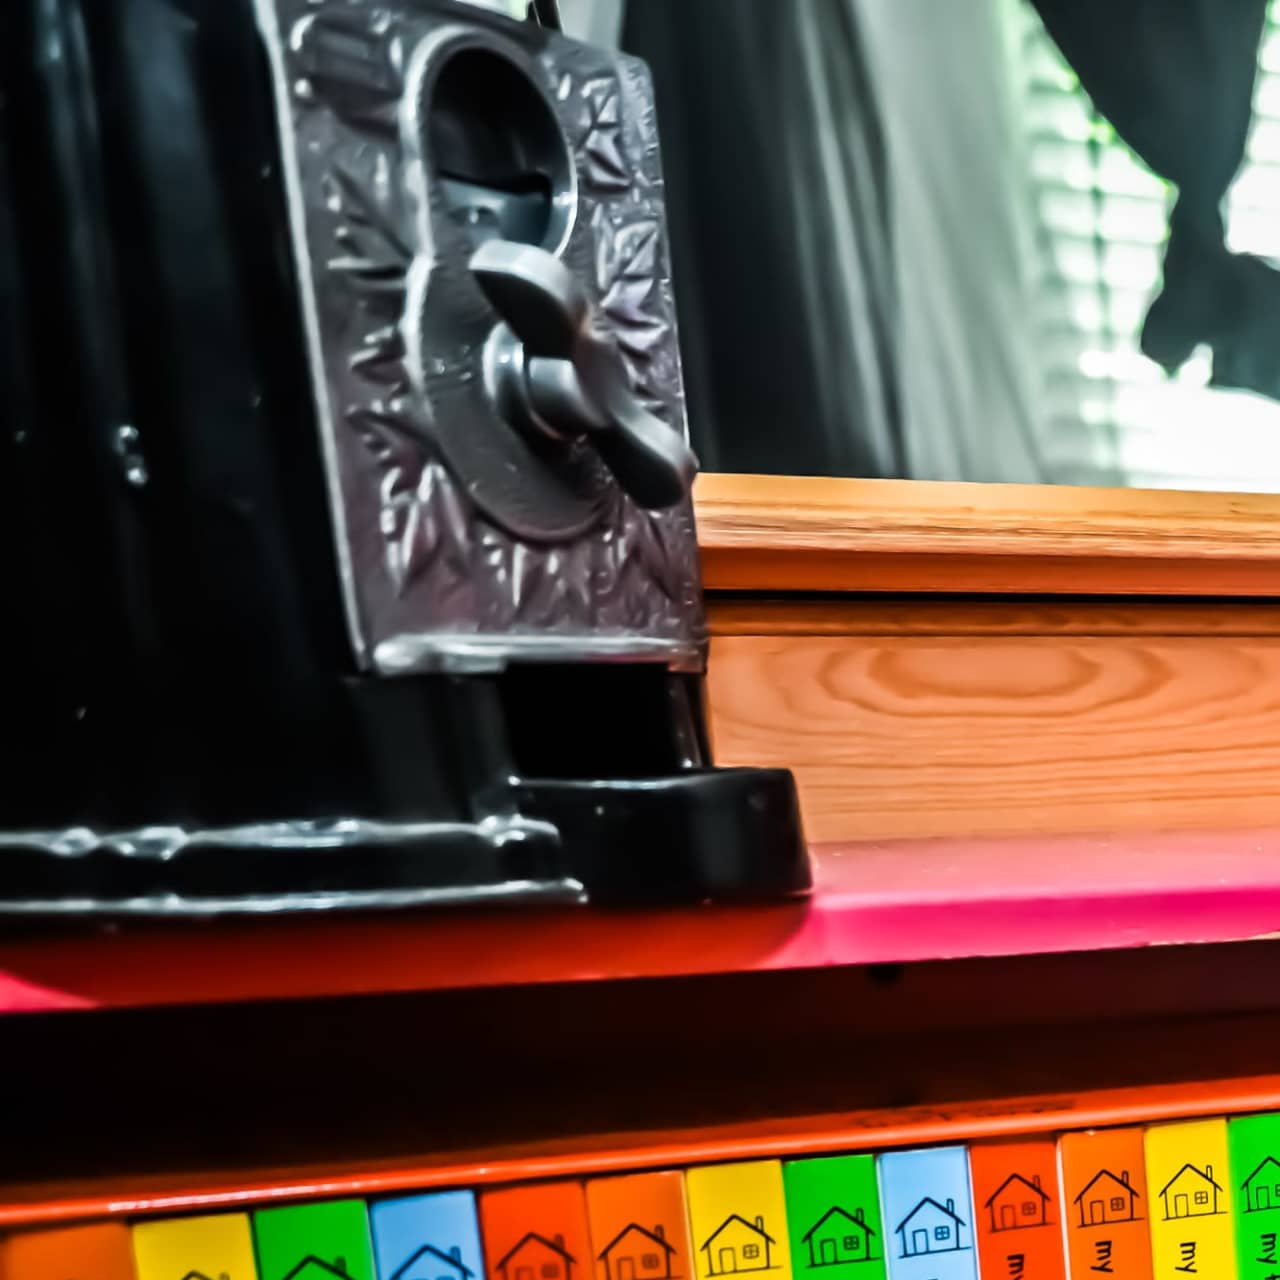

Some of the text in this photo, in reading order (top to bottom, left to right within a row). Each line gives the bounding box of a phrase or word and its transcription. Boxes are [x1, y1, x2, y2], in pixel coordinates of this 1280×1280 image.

[1090, 1240, 1113, 1273] my
[1175, 1241, 1198, 1273] my
[1256, 1233, 1278, 1264] my
